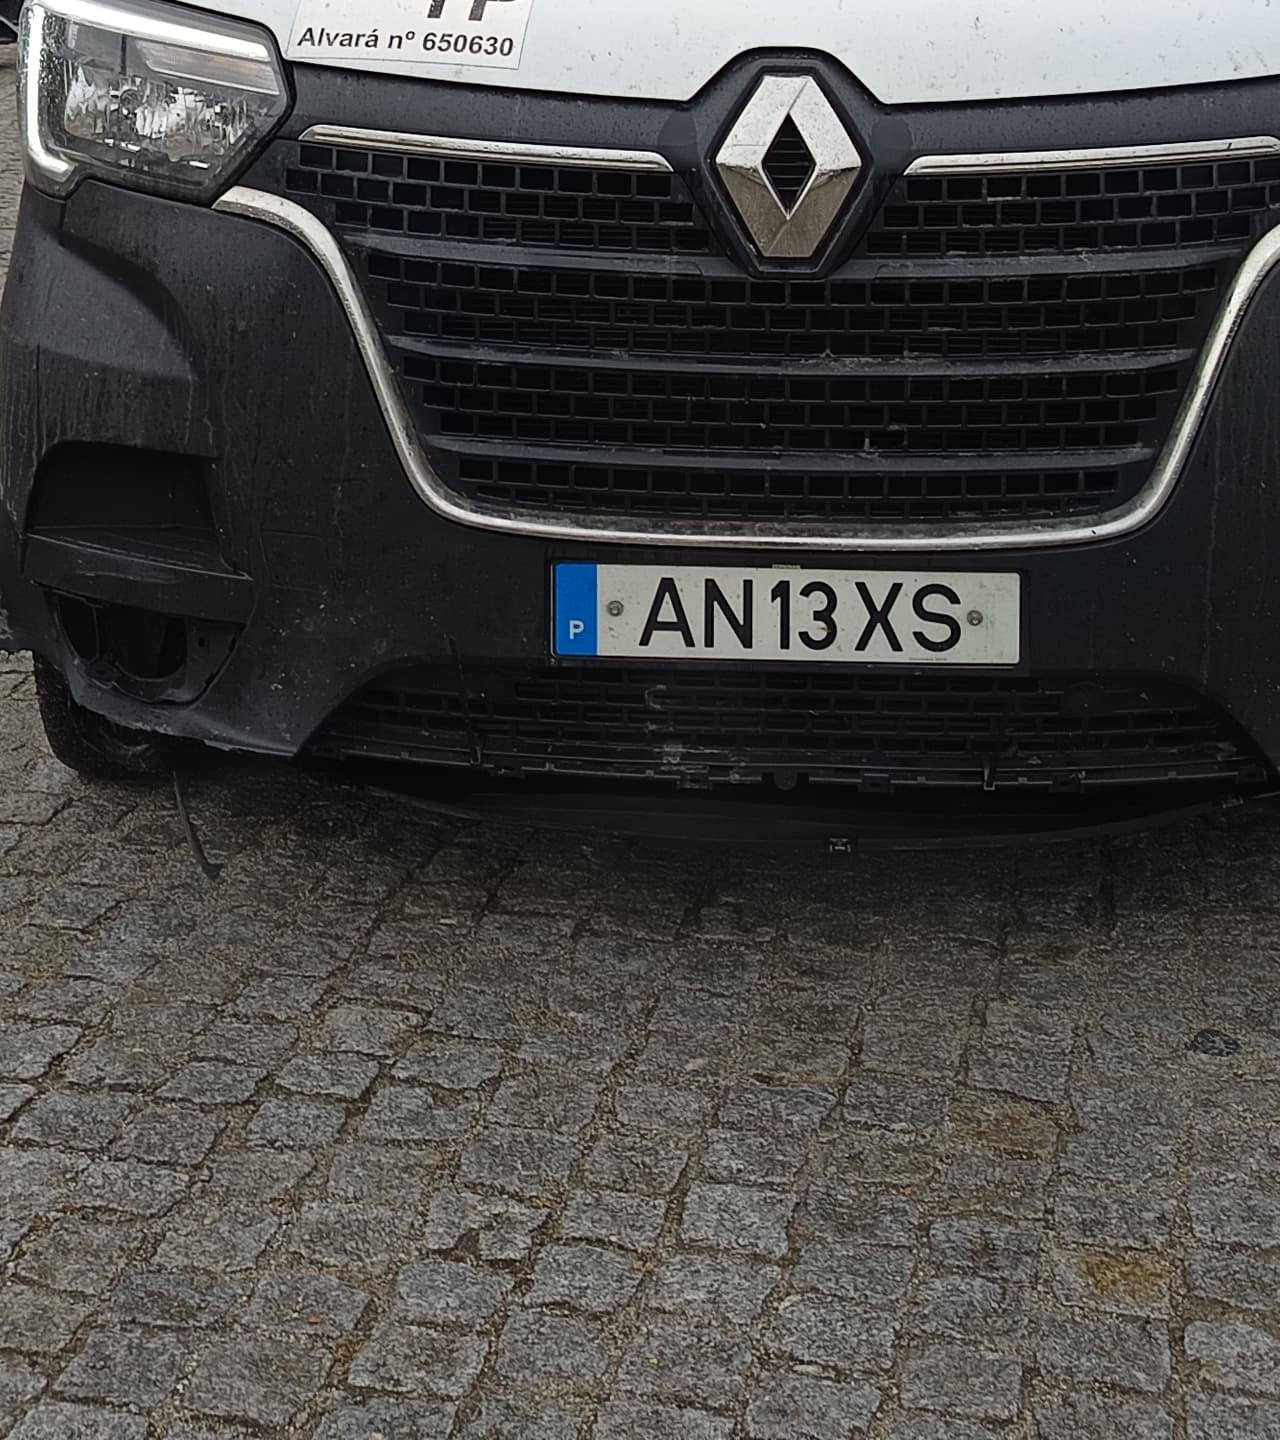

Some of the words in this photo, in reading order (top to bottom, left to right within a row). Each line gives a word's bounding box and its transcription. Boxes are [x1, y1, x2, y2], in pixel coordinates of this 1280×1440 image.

[297, 26, 379, 49] Alvará
[422, 32, 515, 58] 650630
[569, 619, 585, 641] P
